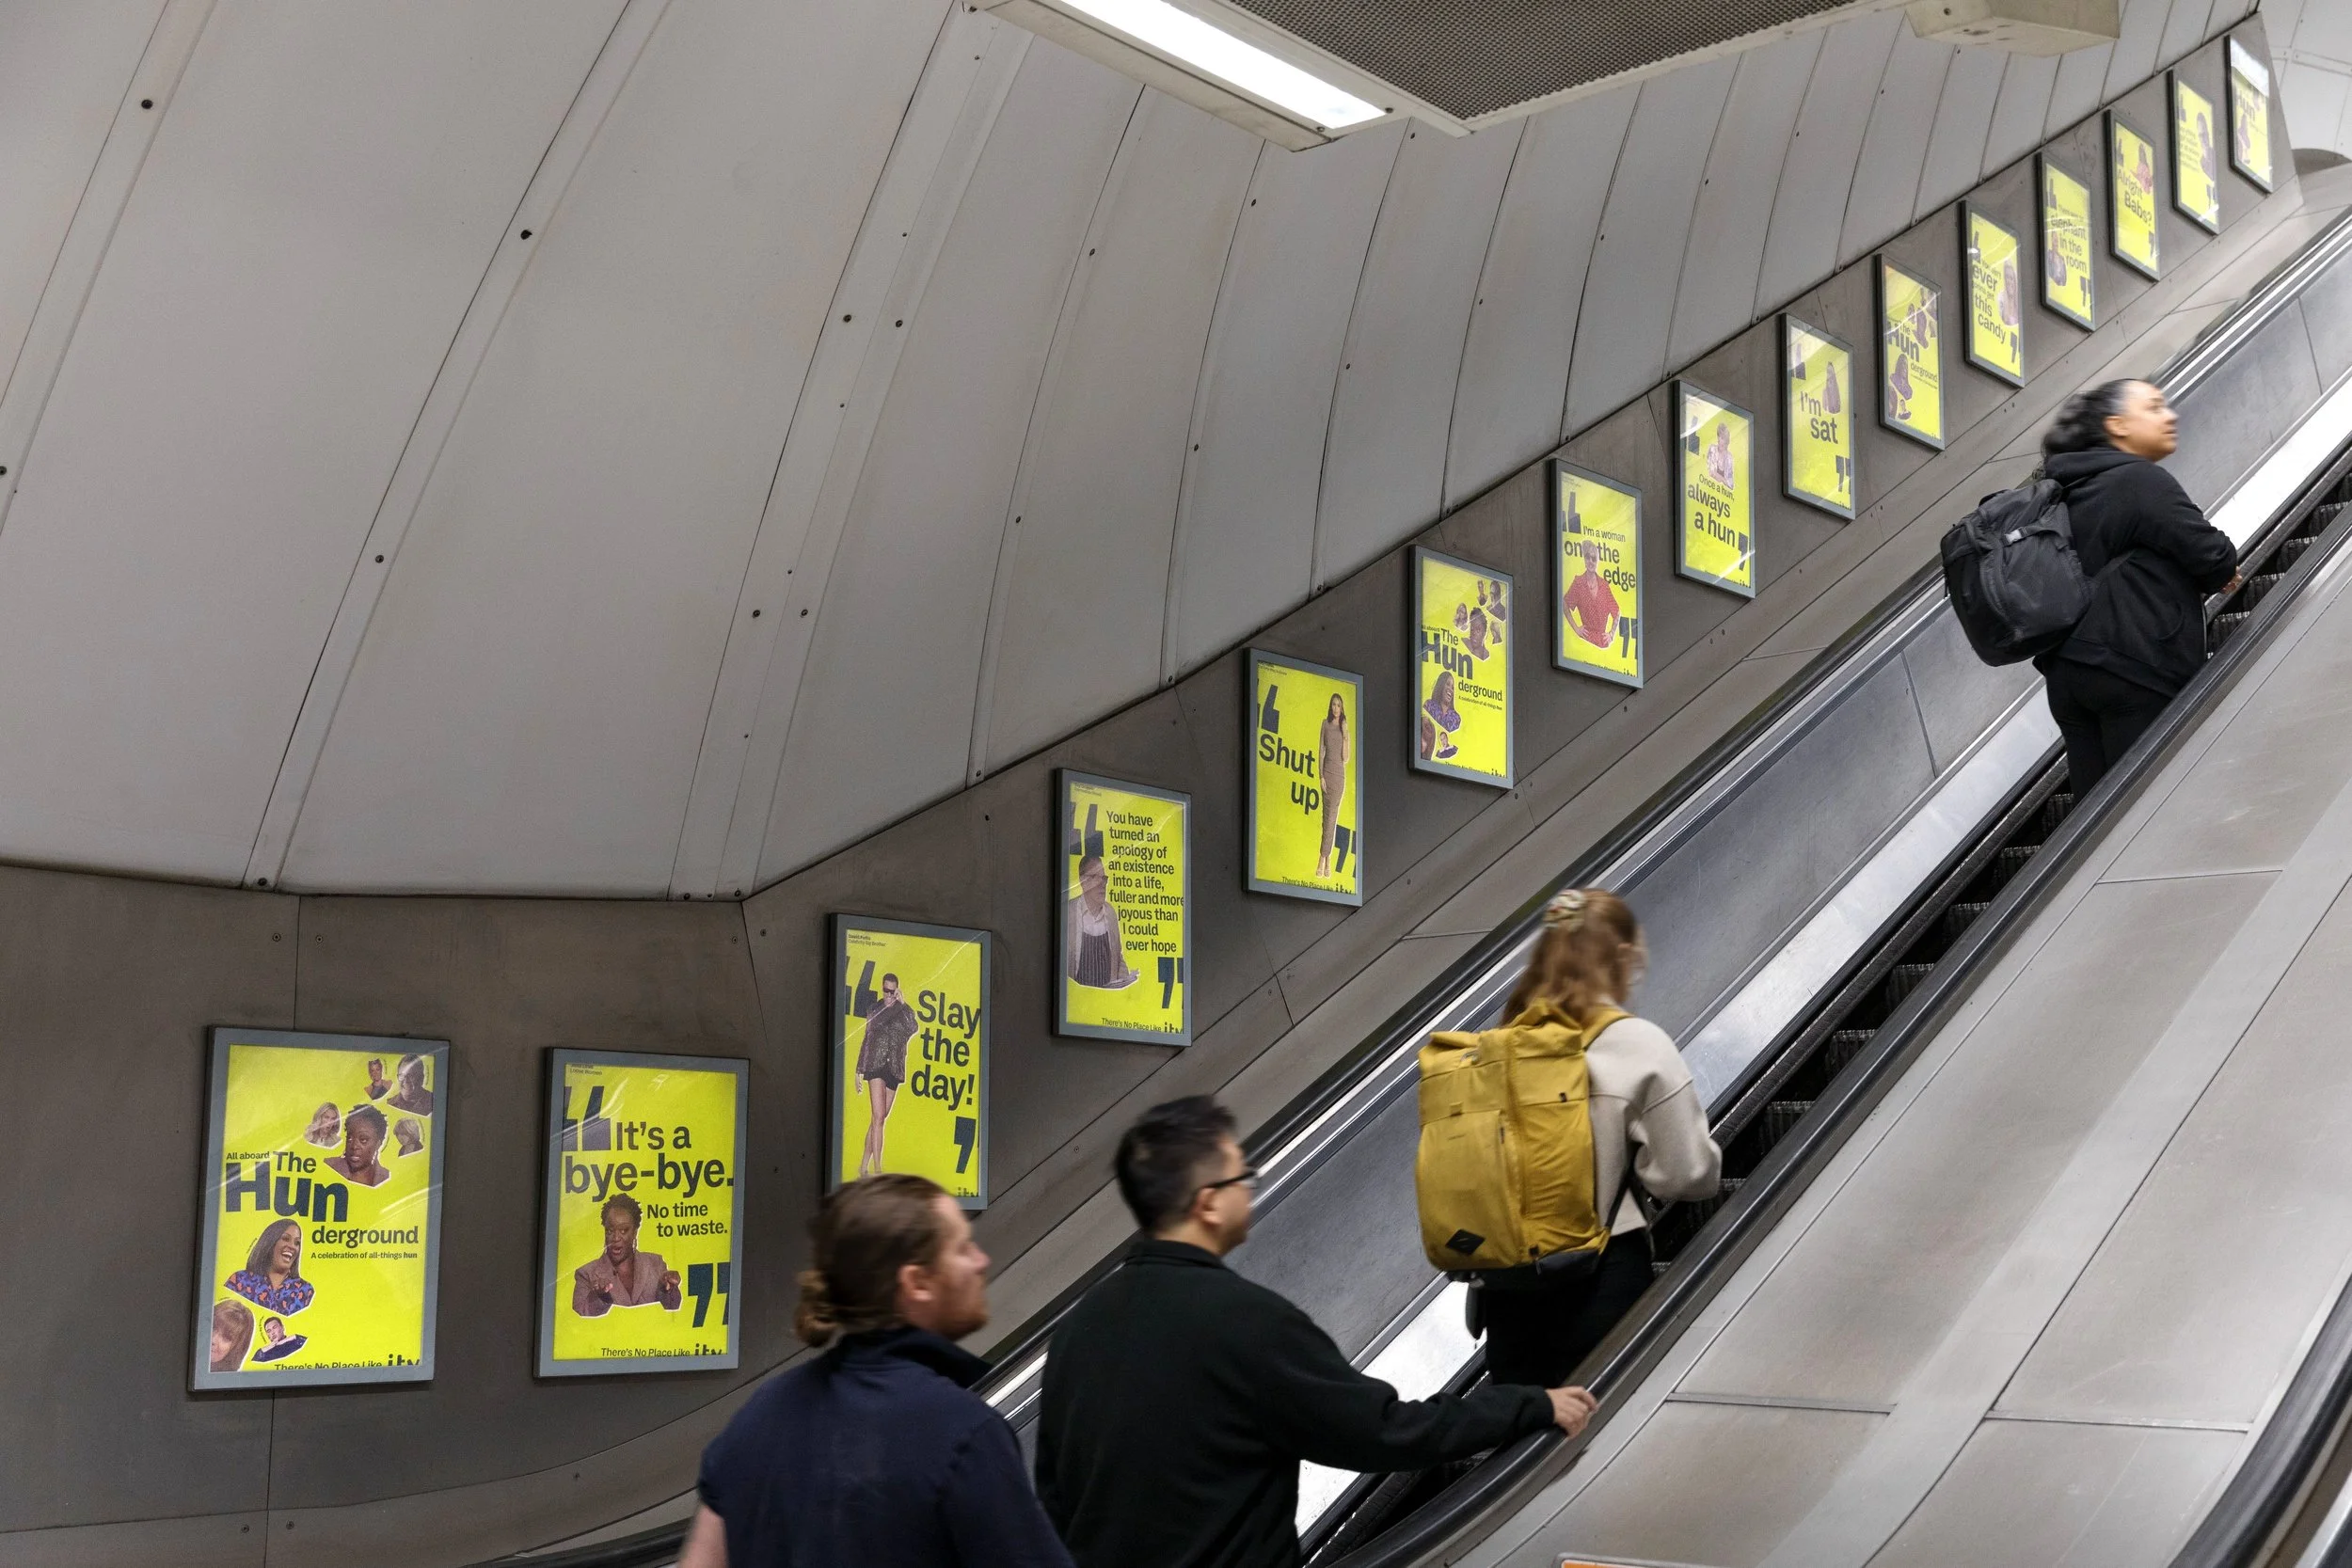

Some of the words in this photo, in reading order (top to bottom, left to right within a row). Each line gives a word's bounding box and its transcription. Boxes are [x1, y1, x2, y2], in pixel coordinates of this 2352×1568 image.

[2059, 232, 2068, 250] in
[2069, 238, 2082, 256] the
[2066, 255, 2087, 273] room
[1973, 263, 1998, 292] ever
[1976, 293, 1993, 317] this
[1979, 312, 2006, 344] candy
[1887, 321, 1919, 363] Hun
[1801, 390, 1821, 417] I'm
[1810, 418, 1838, 444] sat
[1699, 474, 1716, 489] Once
[1688, 483, 1731, 518] always
[1582, 525, 1594, 536] I'm
[1596, 530, 1600, 538] a
[1601, 530, 1626, 542] woman
[1694, 512, 1705, 531] a
[1708, 512, 1735, 547] hun
[1564, 540, 1582, 558] on
[1597, 542, 1620, 564] the
[1603, 566, 1636, 593] edge
[1441, 628, 1458, 645] The
[1422, 630, 1473, 680] Hun
[1458, 679, 1503, 702] derground
[1259, 734, 1316, 779] Shut
[1291, 781, 1320, 816] up
[1106, 811, 1125, 824] You
[1128, 813, 1153, 826] have
[1109, 826, 1144, 841] turned
[1146, 832, 1159, 843] an
[1112, 844, 1153, 861] apology
[1156, 847, 1167, 858] of
[1108, 860, 1121, 871] an
[1123, 860, 1174, 875] existence
[1113, 873, 1133, 888] into
[1135, 878, 1142, 888] a
[1144, 876, 1165, 892] life,
[1109, 890, 1136, 903] fuller
[1138, 892, 1159, 905] and
[1161, 895, 1184, 907] more
[1118, 905, 1152, 922] joyous
[1154, 908, 1178, 922] than
[1123, 922, 1126, 935] I
[1128, 923, 1159, 936] could
[1125, 941, 1149, 952] ever
[1152, 939, 1176, 956] hope
[917, 990, 980, 1038] Slay
[1102, 1018, 1123, 1027] There's
[1123, 1021, 1133, 1029] No
[1133, 1022, 1150, 1031] Place
[1150, 1023, 1161, 1032] Like
[920, 1027, 969, 1067] the
[911, 1064, 975, 1110] day!
[616, 1121, 665, 1151] It's
[673, 1125, 692, 1149] a
[240, 1151, 270, 1160] aboard
[273, 1151, 316, 1174] The
[564, 1153, 734, 1202] bye-bye.
[226, 1161, 349, 1223] Hun
[647, 1204, 670, 1219] No
[673, 1202, 708, 1218] time
[312, 1226, 419, 1249] derground
[657, 1223, 674, 1238] to
[677, 1219, 728, 1236] waste.
[318, 1251, 359, 1259] celebration
[369, 1251, 403, 1260] all-things
[601, 1347, 632, 1356] There's
[649, 1348, 672, 1356] Place
[674, 1348, 691, 1356] Like
